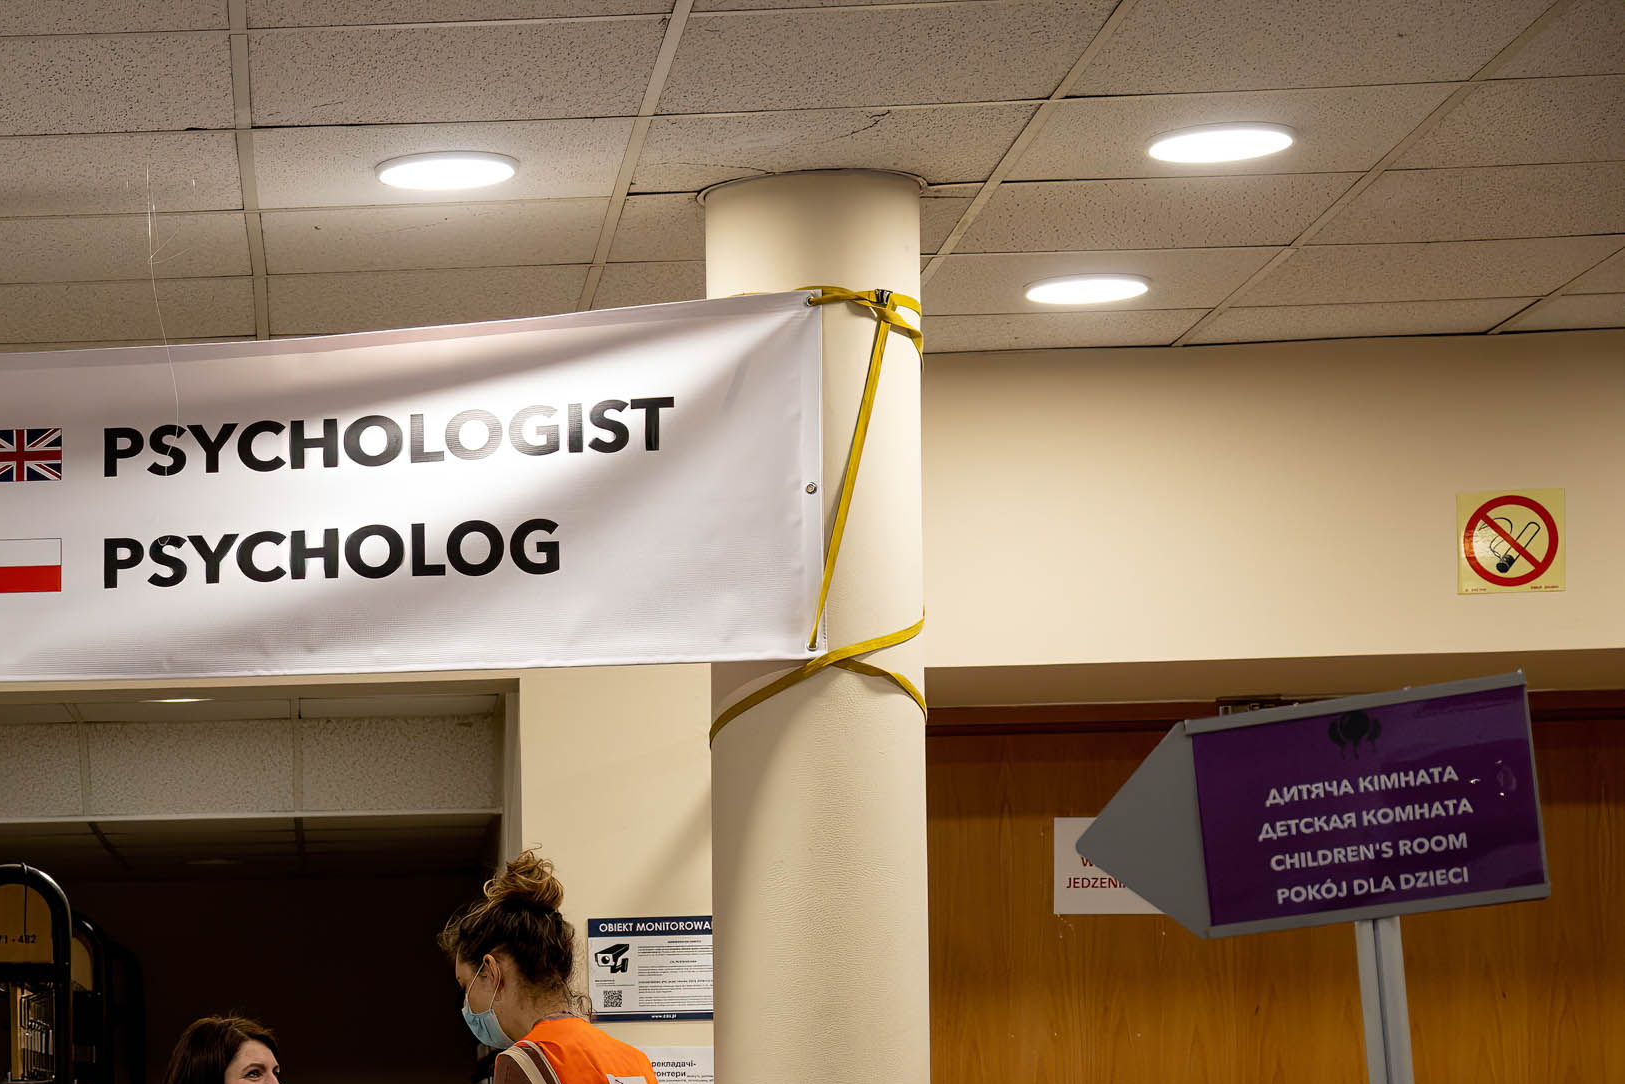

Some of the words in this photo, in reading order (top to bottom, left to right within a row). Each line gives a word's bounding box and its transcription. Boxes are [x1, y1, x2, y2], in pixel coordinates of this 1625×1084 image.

[103, 396, 675, 478] PSYCHOLOGIST
[103, 518, 560, 589] PSYCHOLOG
[1265, 778, 1355, 807] ДИТЯЧА
[1359, 765, 1459, 792] КІМНАТА
[1258, 811, 1357, 842] ДЕТСКАЯ
[1362, 797, 1474, 826] КОМНАТА
[1270, 841, 1393, 871] CHILDREN'S
[1398, 832, 1468, 857] ROOM
[1277, 878, 1347, 904] POKÓJ
[1353, 875, 1396, 896] DLA
[1399, 866, 1469, 890] DZIECI
[599, 922, 633, 933] OBIEKT
[636, 920, 713, 932] MONITOROWA
[652, 1060, 697, 1068] рекладачі-
